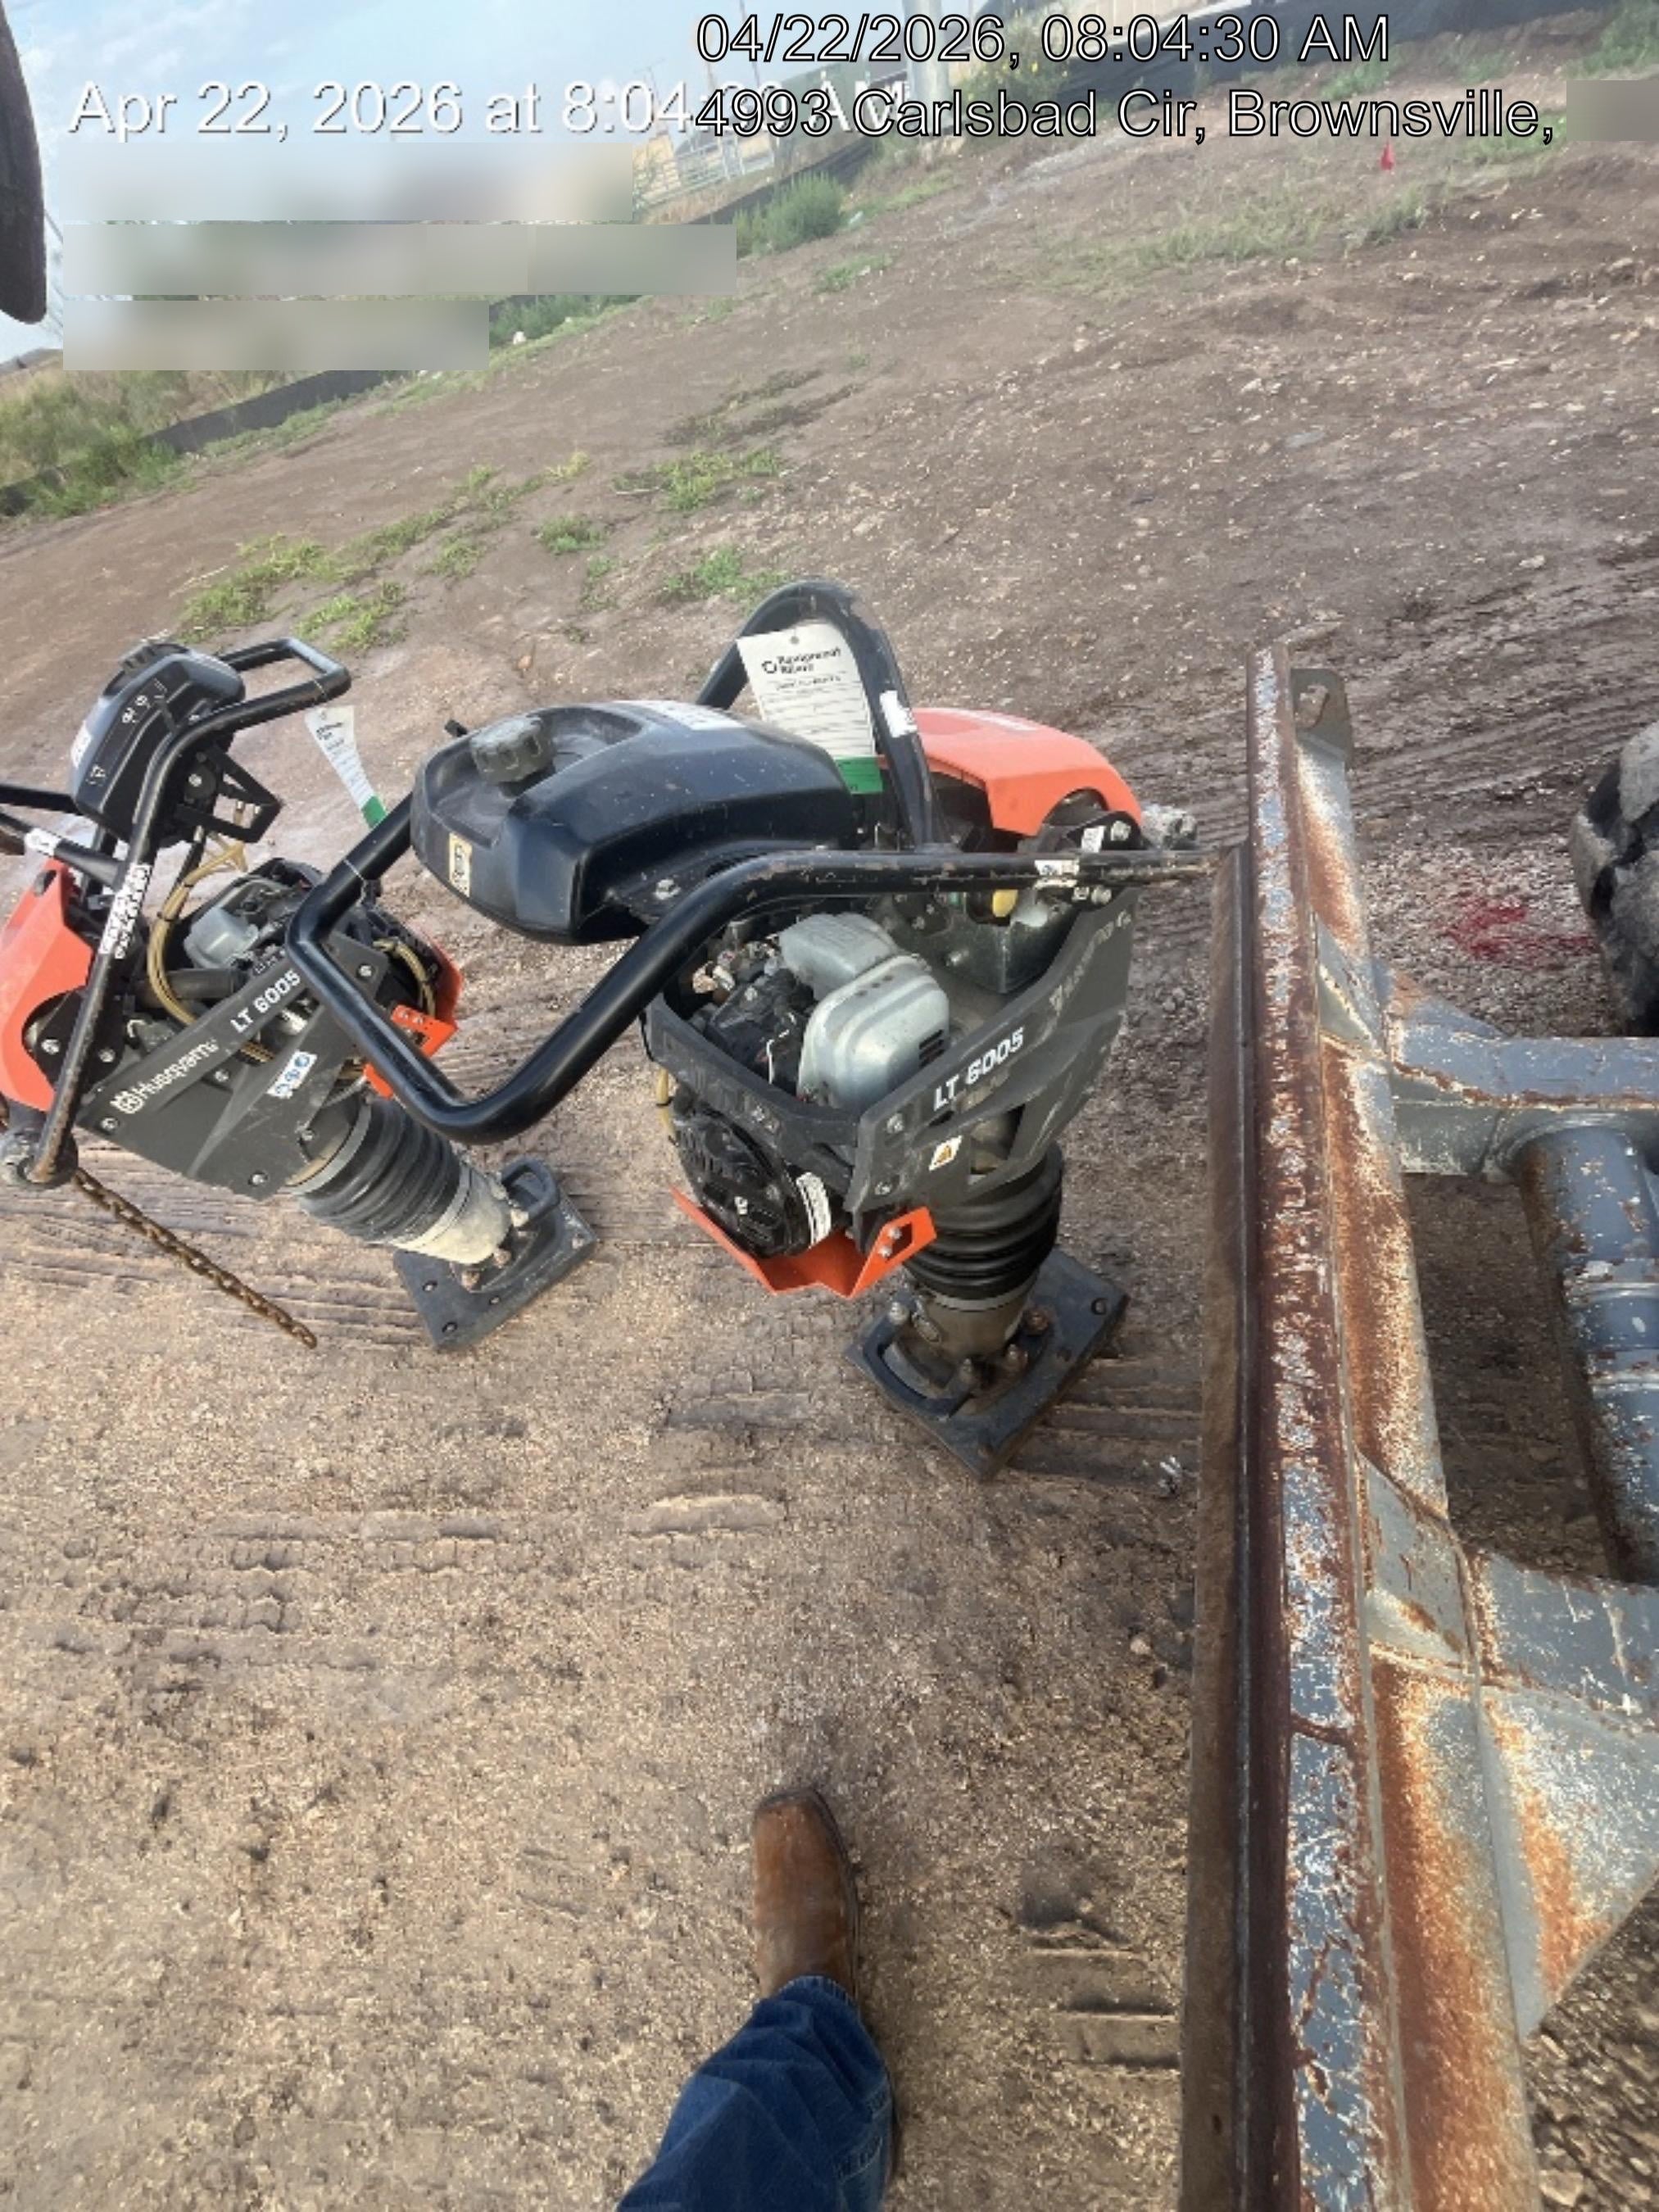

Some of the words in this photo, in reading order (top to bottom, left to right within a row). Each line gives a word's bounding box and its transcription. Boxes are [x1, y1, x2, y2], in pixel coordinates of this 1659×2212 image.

[230, 1008, 254, 1033] LT
[252, 969, 301, 1014] 6005
[933, 1073, 959, 1112] LT
[965, 1025, 1025, 1086] 6005
